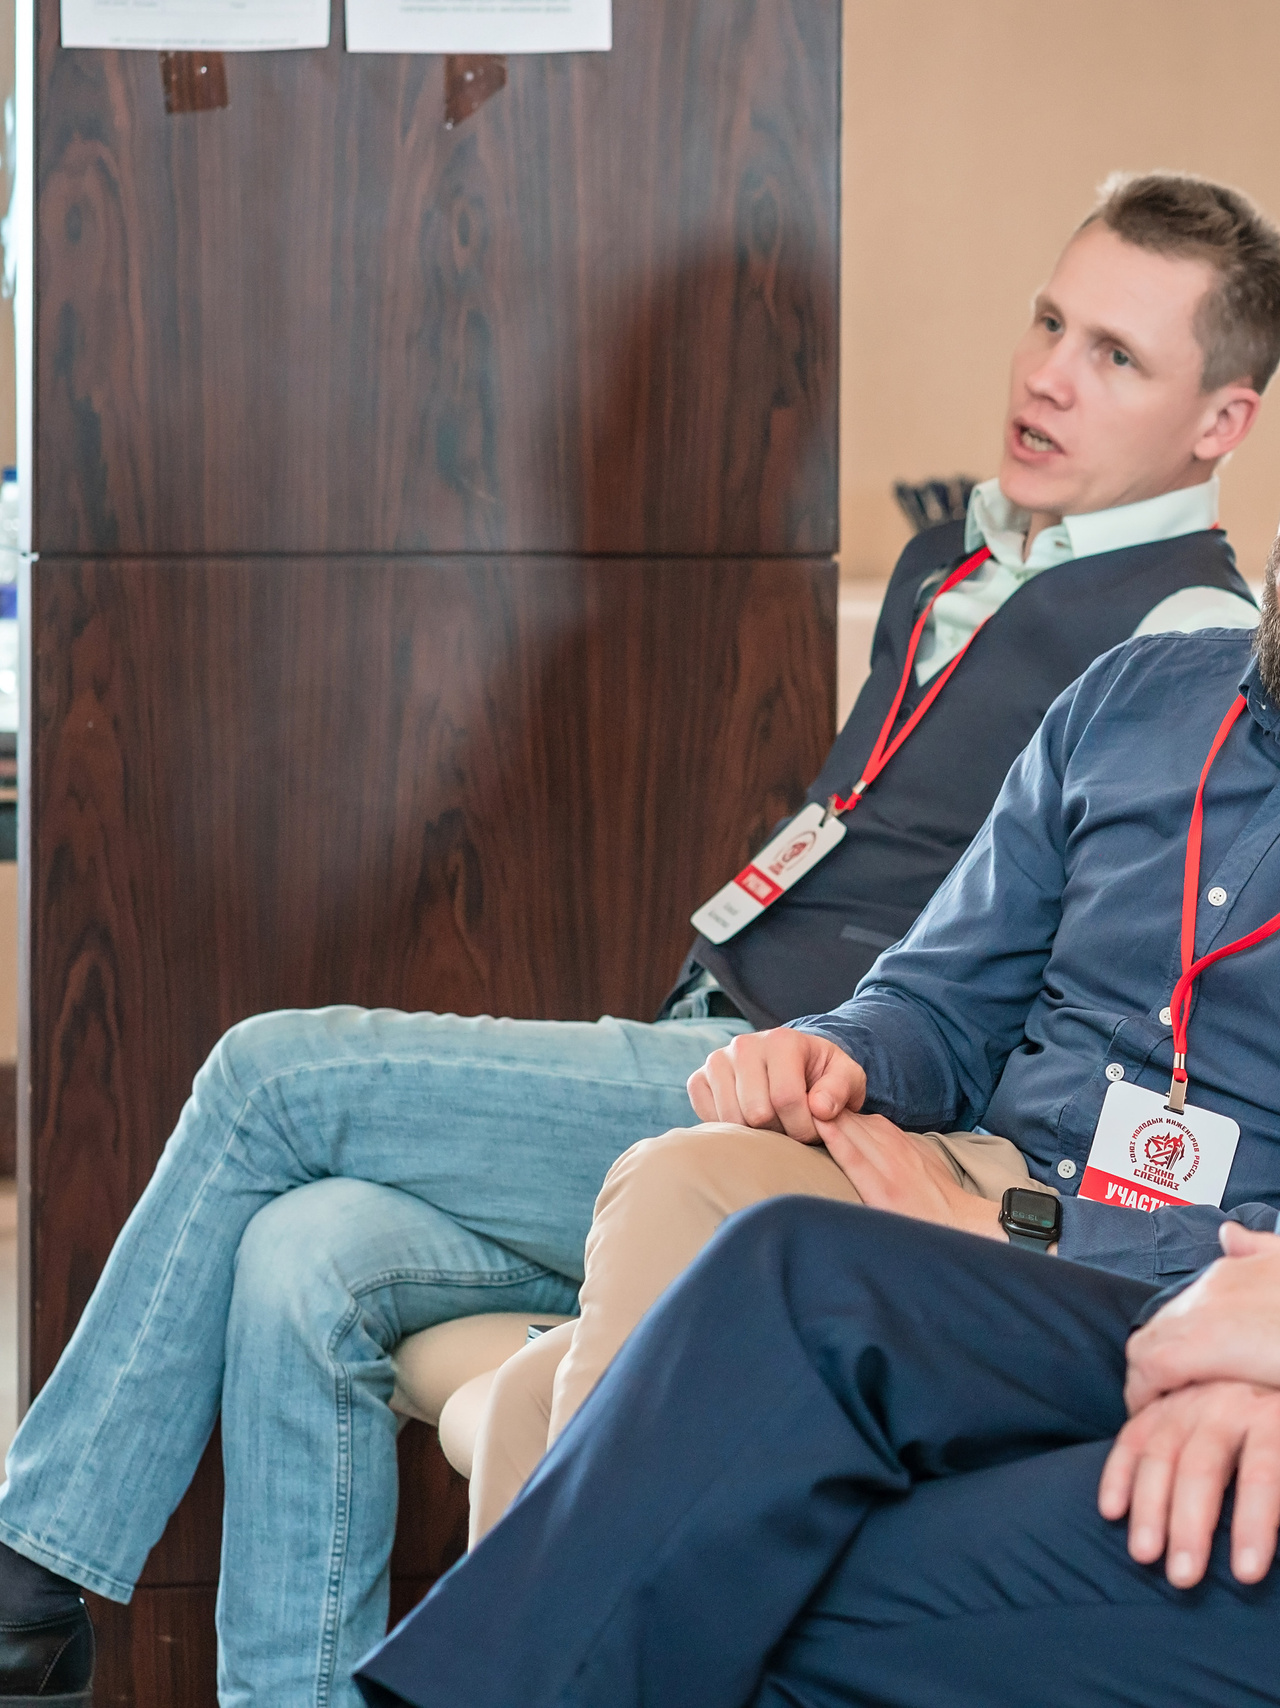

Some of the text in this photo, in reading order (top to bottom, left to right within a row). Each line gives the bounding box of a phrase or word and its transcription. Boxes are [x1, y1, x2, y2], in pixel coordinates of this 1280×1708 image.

[1129, 1117, 1200, 1182] СОЮЗ МОЛОДЫХ ИНЖЕНЕРОВ РОССИИ
[1133, 1168, 1180, 1191] СПЕЦНАЗ
[1143, 1163, 1175, 1180] ТЕХНО
